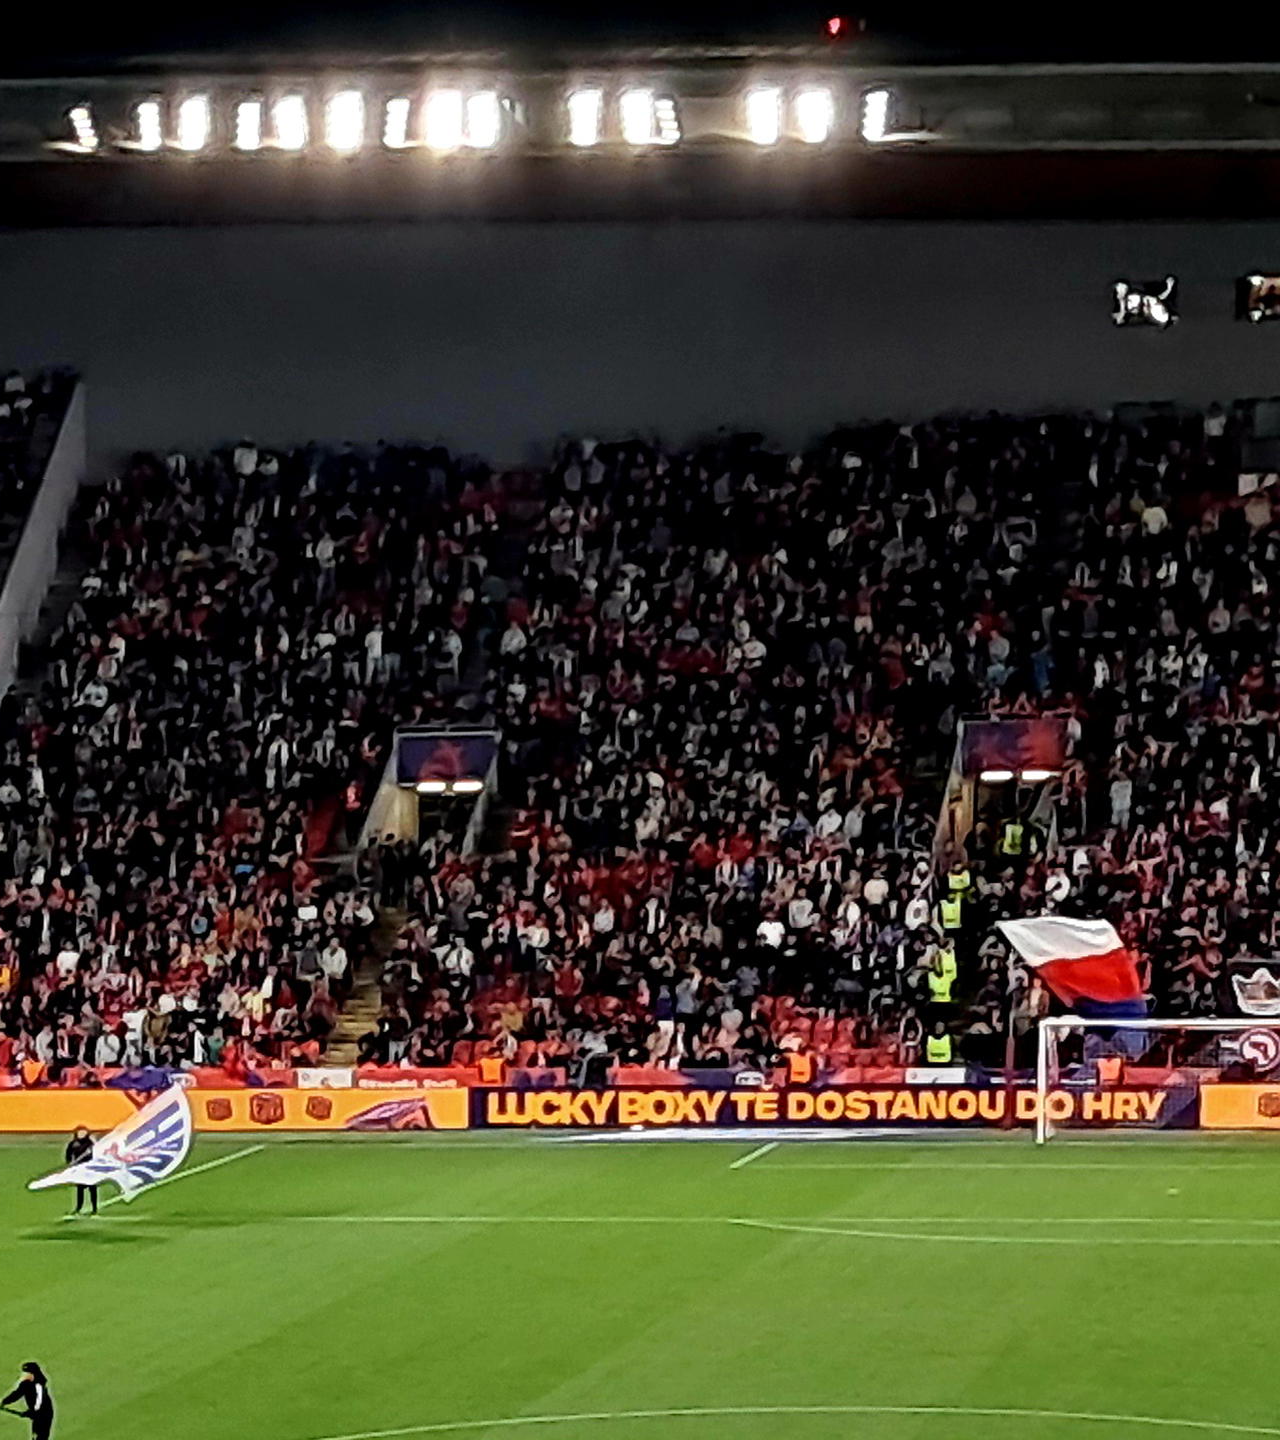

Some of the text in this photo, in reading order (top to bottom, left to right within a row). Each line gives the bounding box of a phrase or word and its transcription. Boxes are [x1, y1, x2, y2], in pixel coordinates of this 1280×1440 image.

[487, 1089, 1168, 1125] LUCKY BOXY TE DOSTANOU DO HRY
